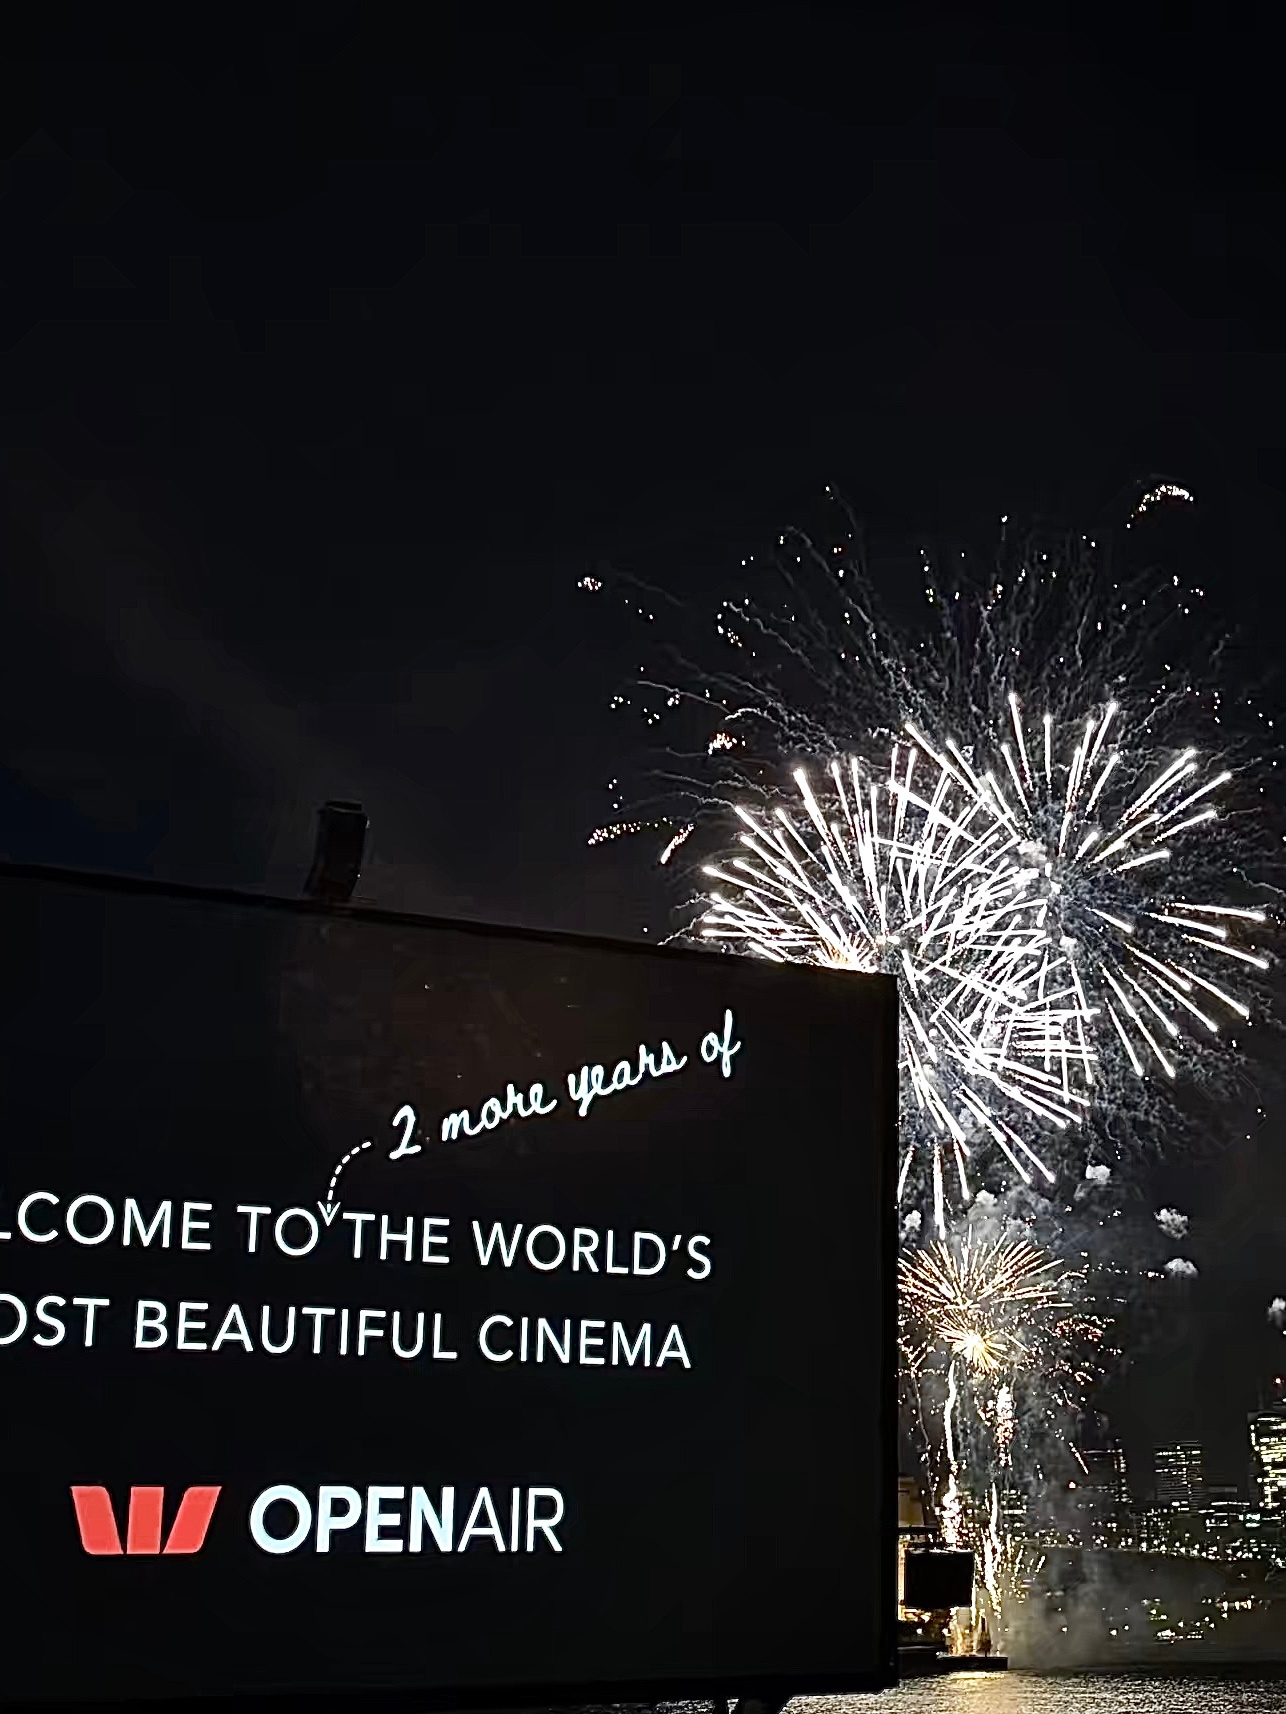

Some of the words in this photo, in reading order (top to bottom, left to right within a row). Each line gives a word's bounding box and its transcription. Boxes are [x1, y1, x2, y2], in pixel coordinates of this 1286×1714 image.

[387, 1103, 423, 1161] 2
[440, 1081, 559, 1143] more
[566, 1039, 689, 1119] years
[699, 1007, 743, 1079] of
[236, 1204, 320, 1256] TO
[342, 1211, 451, 1265] THE
[471, 1219, 713, 1281] WORLD'S
[133, 1299, 459, 1361] BEAUTIFUL
[477, 1314, 693, 1370] CINEMA
